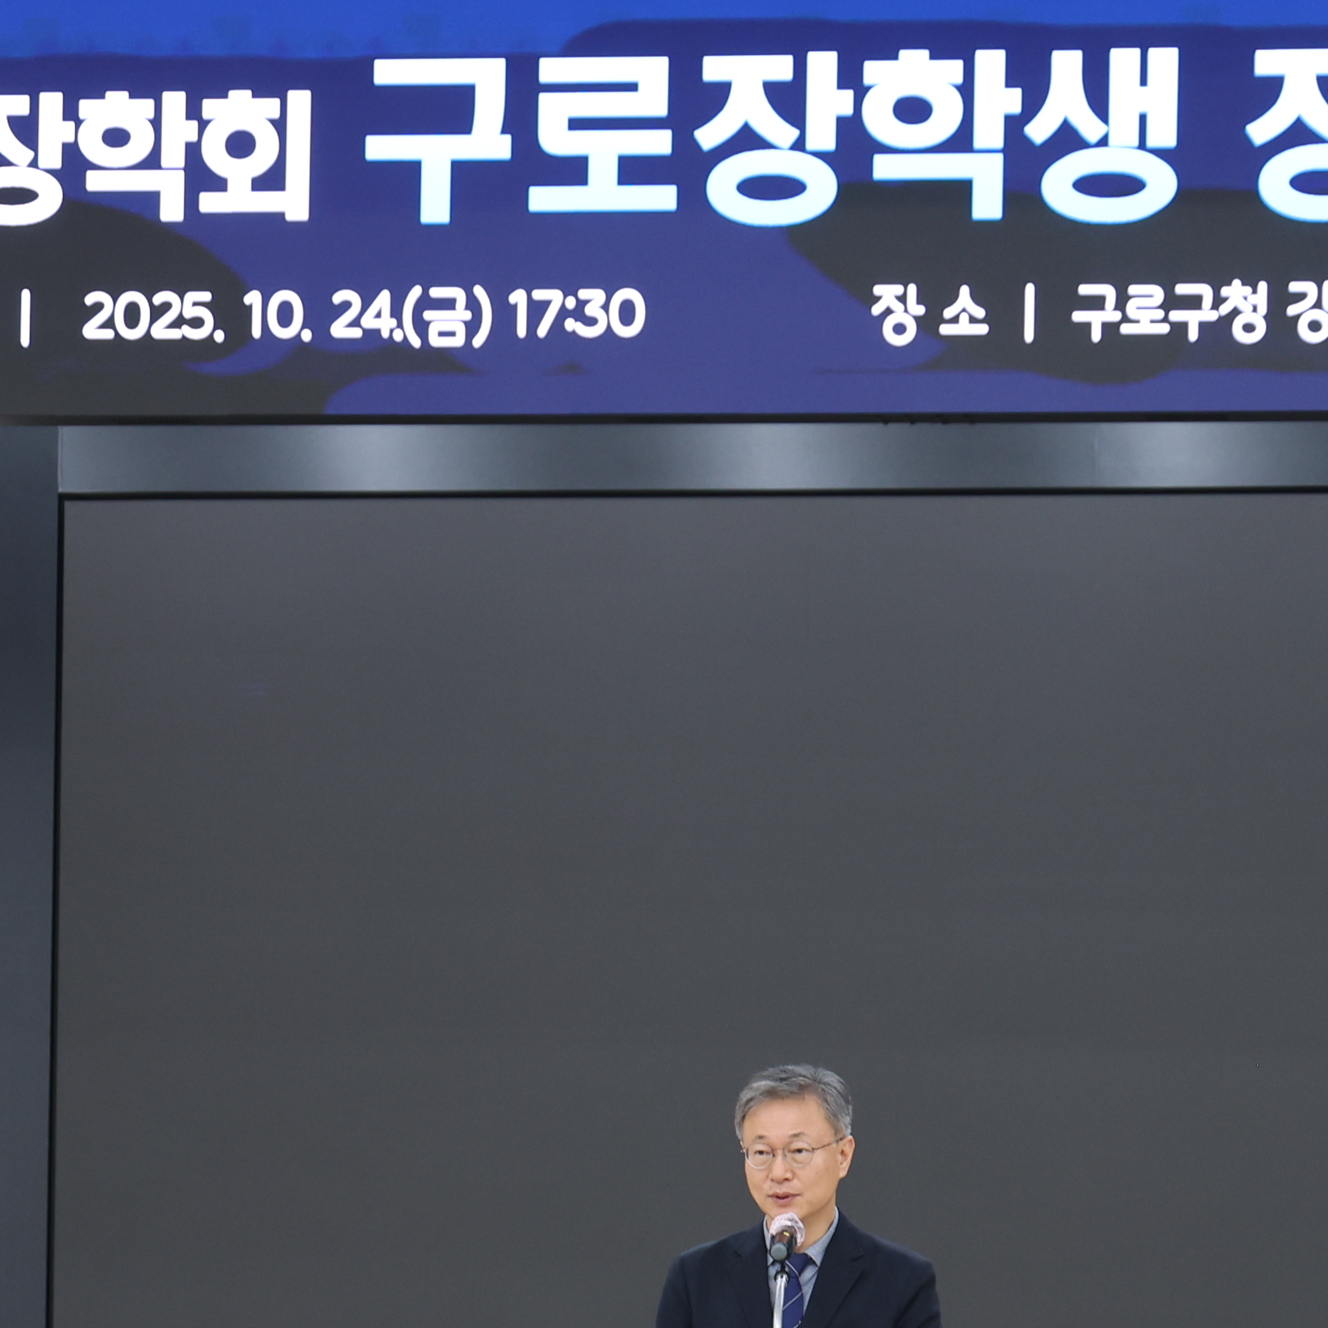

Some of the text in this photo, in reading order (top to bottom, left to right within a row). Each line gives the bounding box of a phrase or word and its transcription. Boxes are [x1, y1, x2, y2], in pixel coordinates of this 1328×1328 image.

[364, 45, 1180, 227] 구로장학생
[80, 289, 226, 345] 2025.
[241, 288, 314, 344] 10.
[328, 283, 494, 350] 24.(금)
[507, 286, 647, 340] 17:30
[1070, 277, 1269, 346] 구로구청
